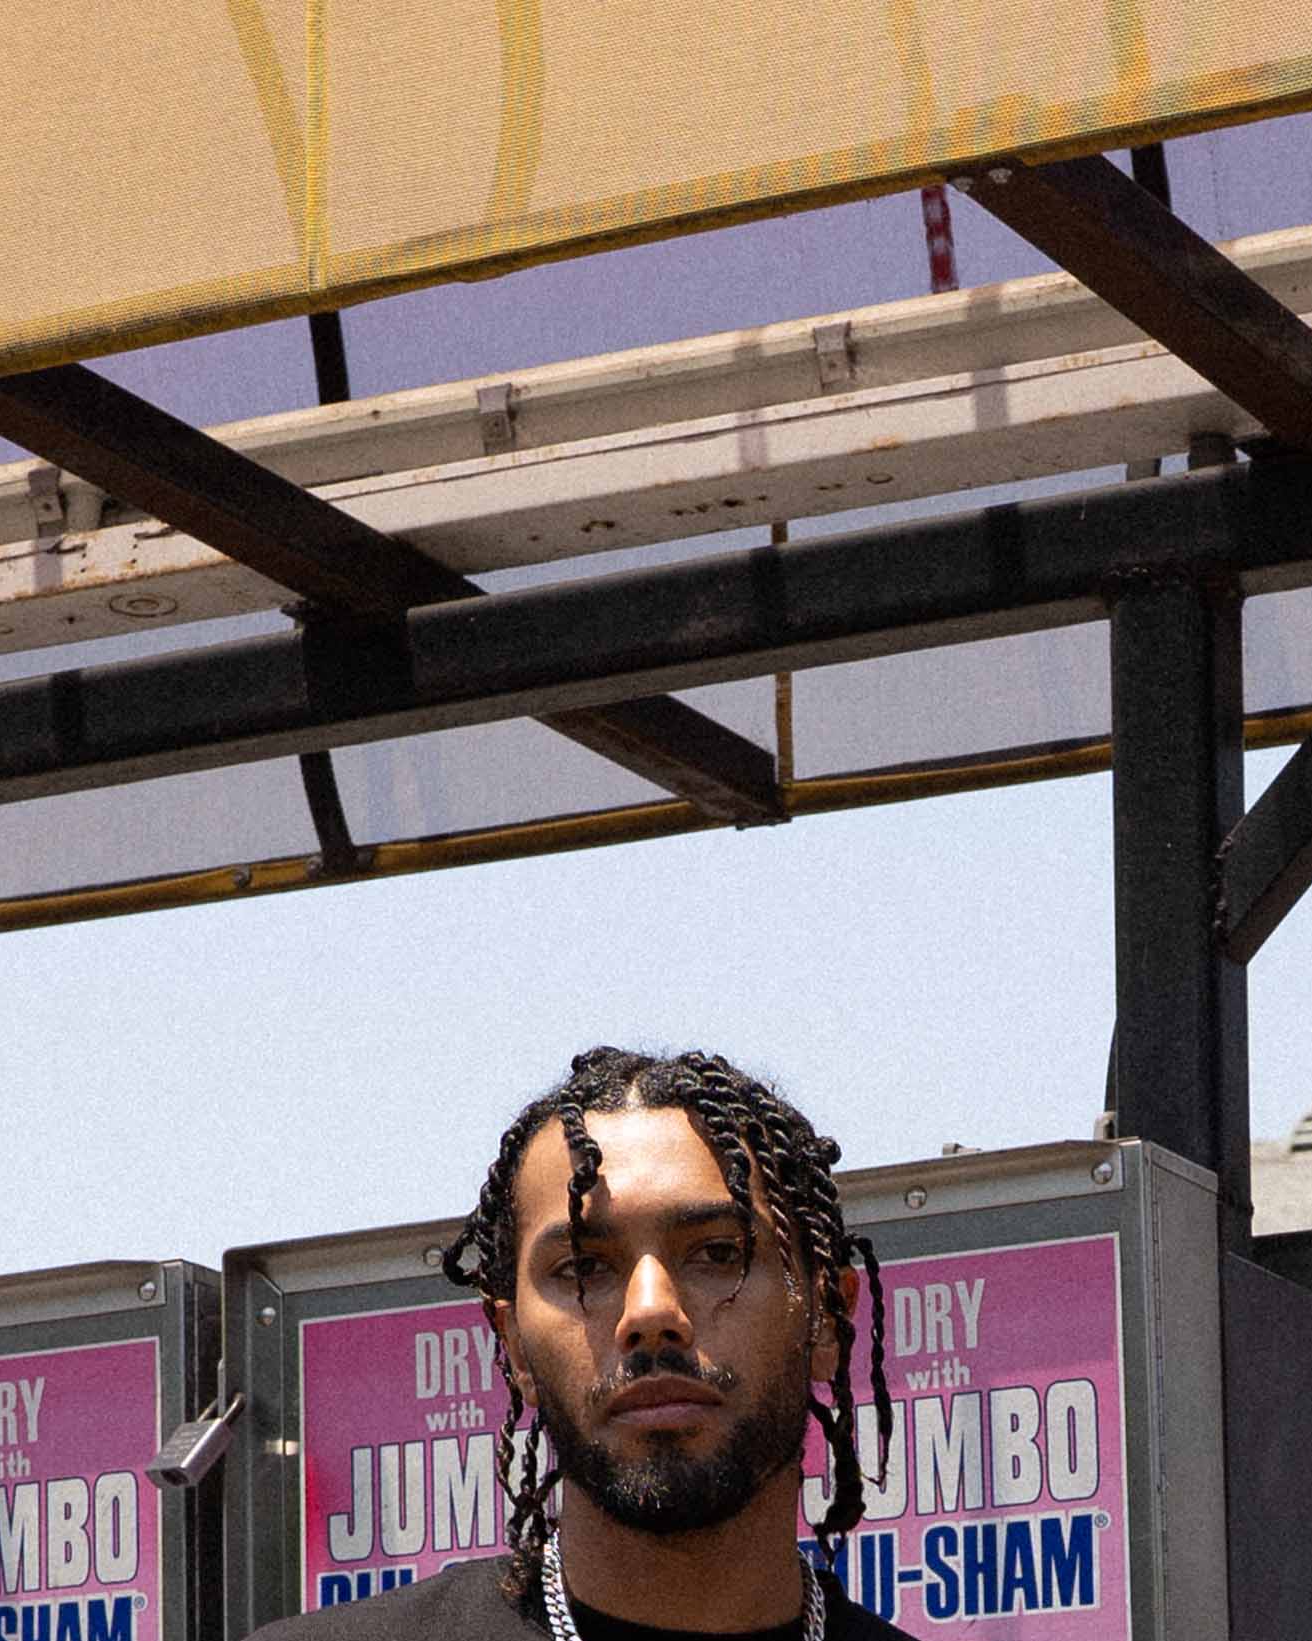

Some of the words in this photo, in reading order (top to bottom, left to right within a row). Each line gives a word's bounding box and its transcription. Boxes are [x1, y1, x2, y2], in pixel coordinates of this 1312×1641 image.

[892, 1278, 986, 1358] DRY
[414, 1326, 496, 1399] DRY
[906, 1357, 971, 1391] with
[425, 1401, 485, 1432] with
